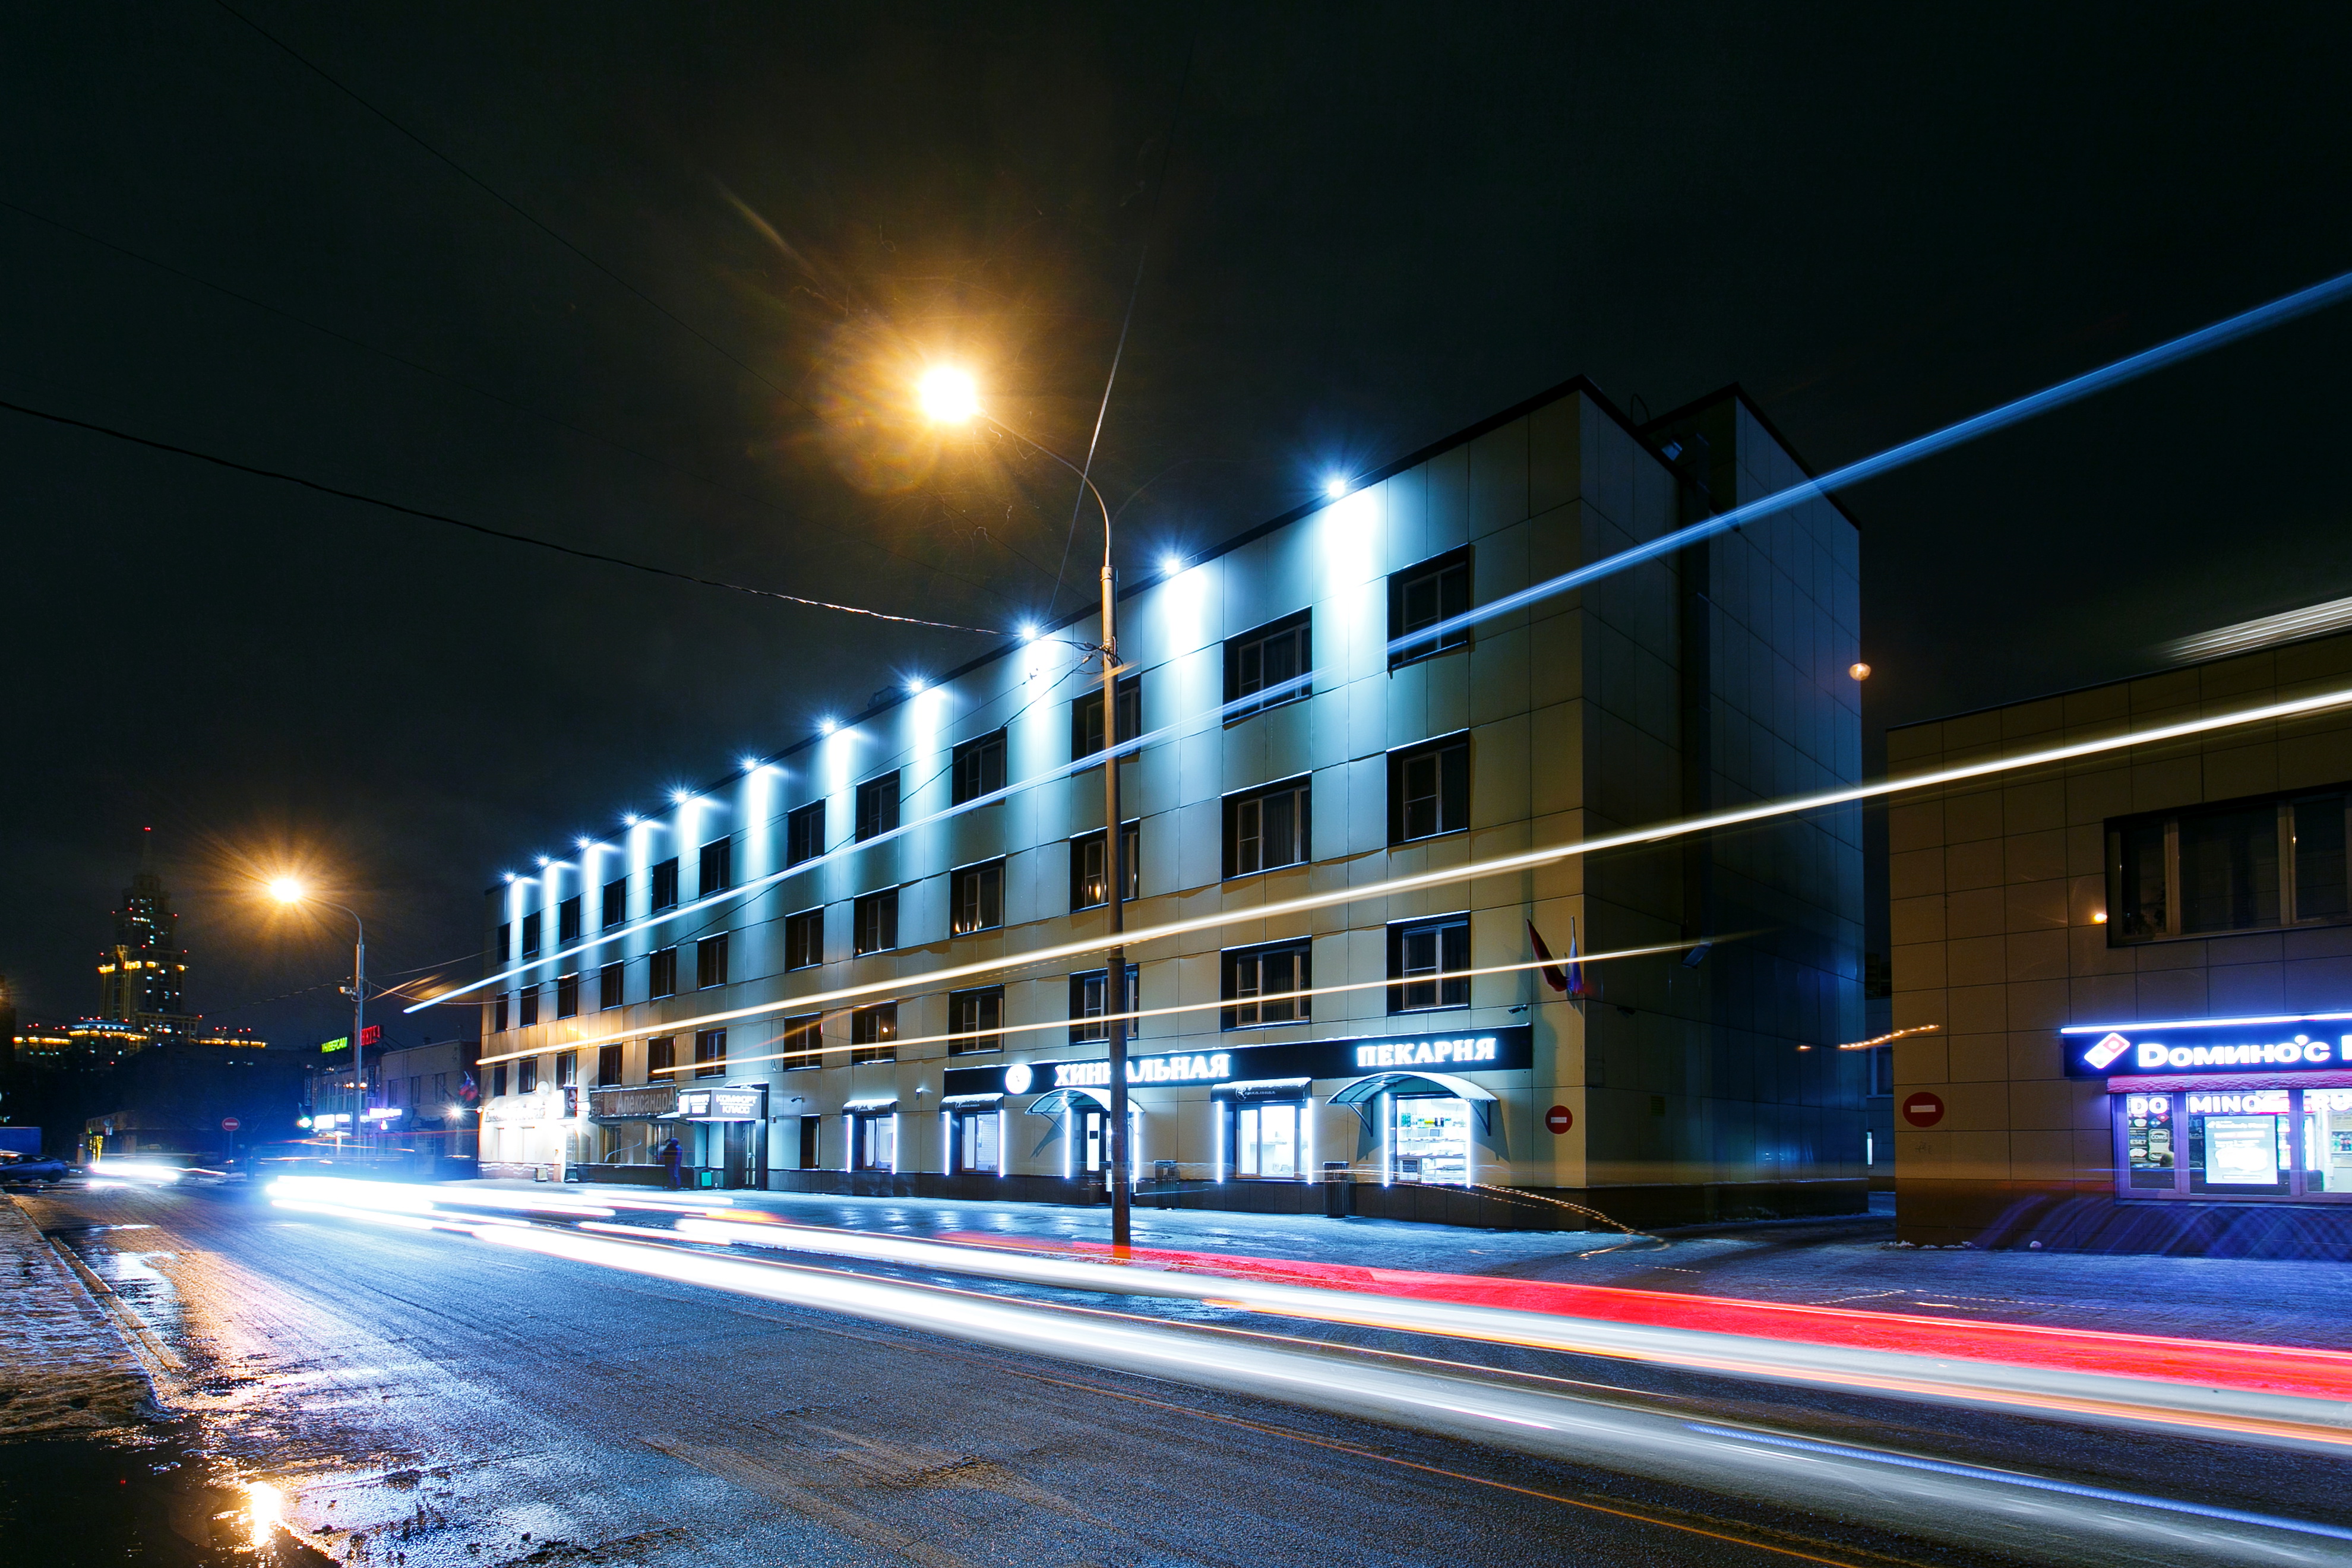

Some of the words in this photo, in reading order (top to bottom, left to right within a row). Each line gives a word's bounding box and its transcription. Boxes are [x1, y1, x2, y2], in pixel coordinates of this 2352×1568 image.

[1357, 1037, 1497, 1067] ПЕКАРНЯ
[616, 1087, 675, 1114] АлександрА
[715, 1094, 758, 1104] КОМФОРТ
[2130, 1097, 2168, 1114] DO
[722, 1105, 750, 1114] КЛАСС
